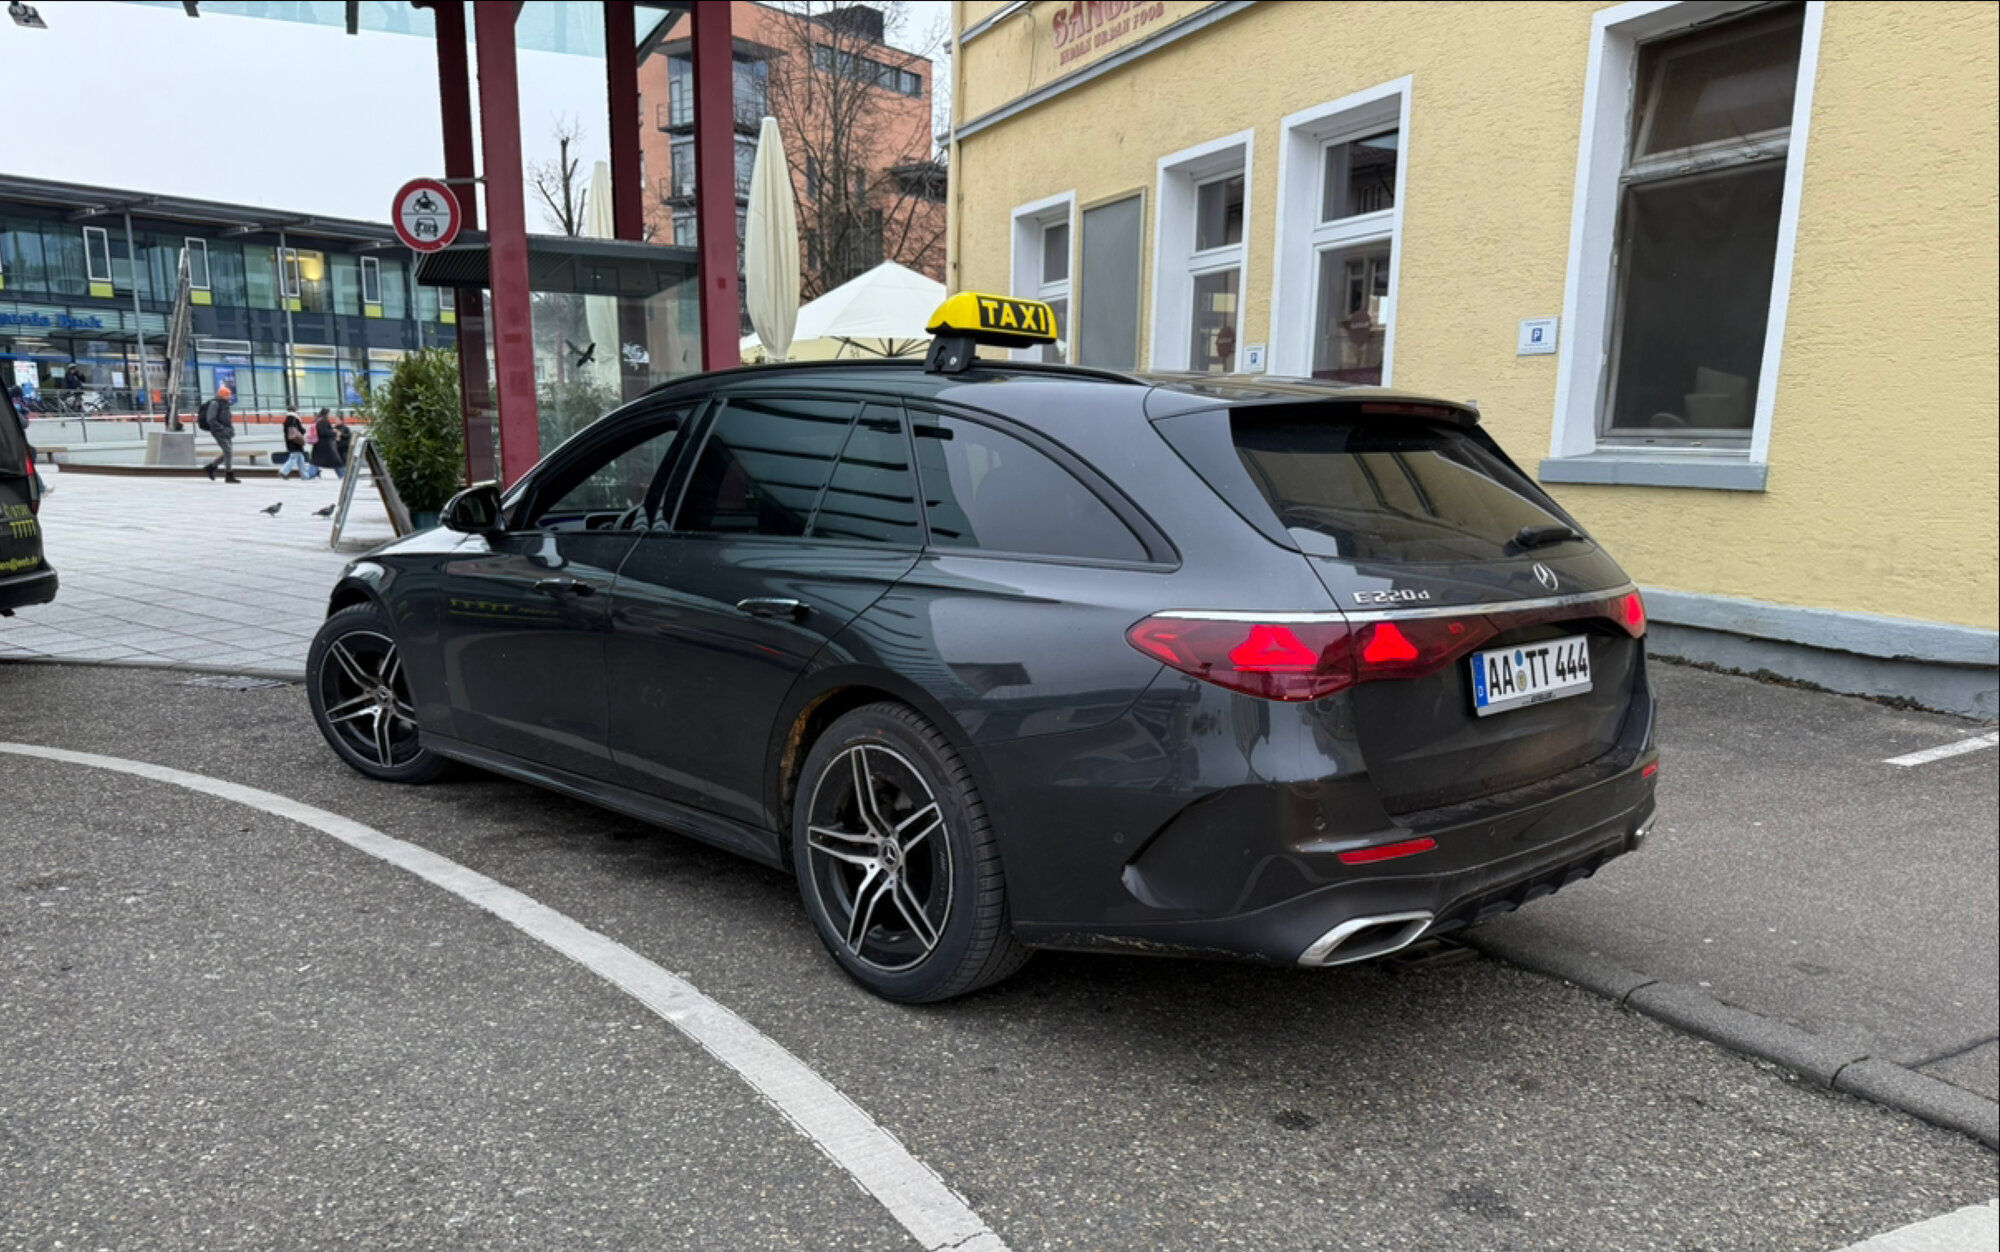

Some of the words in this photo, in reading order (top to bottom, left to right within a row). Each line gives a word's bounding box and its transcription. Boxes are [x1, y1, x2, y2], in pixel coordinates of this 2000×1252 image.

[1094, 17, 1130, 48] URBAN
[1133, 2, 1164, 30] FOOD
[980, 299, 1047, 331] TAXI
[1353, 591, 1369, 604] E
[1489, 655, 1515, 697] AA
[1525, 648, 1549, 688] TT
[1556, 642, 1588, 682] 444
